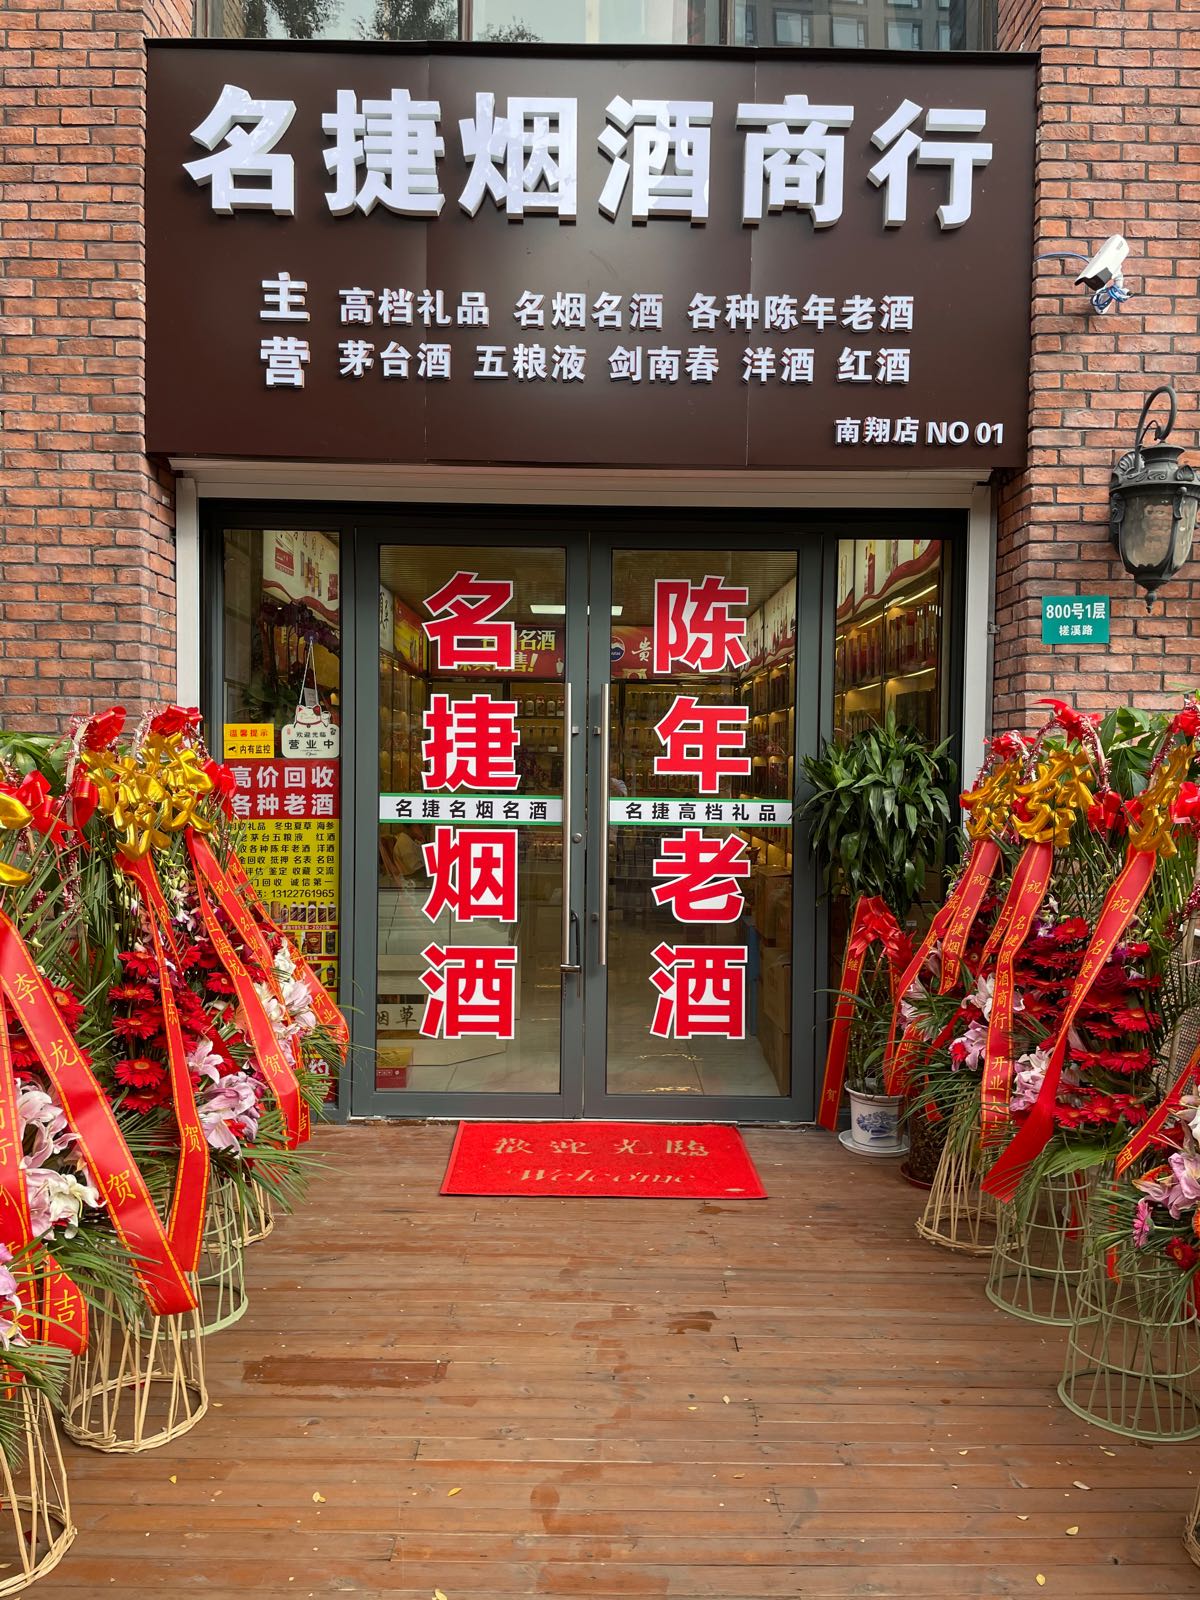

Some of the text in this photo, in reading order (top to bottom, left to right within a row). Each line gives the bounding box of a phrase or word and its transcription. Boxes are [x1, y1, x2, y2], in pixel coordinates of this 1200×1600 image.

[182, 84, 994, 230] 名捷烟酒商行
[338, 287, 915, 333] 高档礼品 名烟名酒 各种陈年老酒
[260, 272, 310, 388] 主营
[338, 340, 911, 385] 茅台酒 五粮液 剑南春 洋酒 红酒
[834, 416, 1004, 446] 南翔店 NO 01
[1046, 602, 1106, 620] 800号1层
[230, 729, 268, 738] 温馨提示
[288, 739, 335, 750] 营业中
[240, 744, 271, 755] 内有监控
[229, 765, 334, 789] 高价回收
[230, 793, 334, 816] 各种老酒
[395, 798, 548, 820] 名捷名烟名酒
[419, 571, 521, 1040] 名捷烟酒
[625, 802, 776, 822] 名捷高档礼品
[649, 575, 751, 1040] 陈年老酒
[275, 821, 312, 831] 冬虫夏草
[316, 821, 335, 831] 海参
[315, 833, 336, 842] 红酒
[294, 855, 312, 865] 名表
[316, 855, 335, 865] 名包
[316, 844, 335, 853] 洋酒
[290, 878, 334, 887] 诚信第一
[316, 867, 335, 876] 交流
[992, 915, 1027, 1030] 名捷烟酒商行
[264, 1053, 285, 1078] 贺
[184, 1123, 202, 1154] 贺
[106, 1169, 137, 1207] 贺
